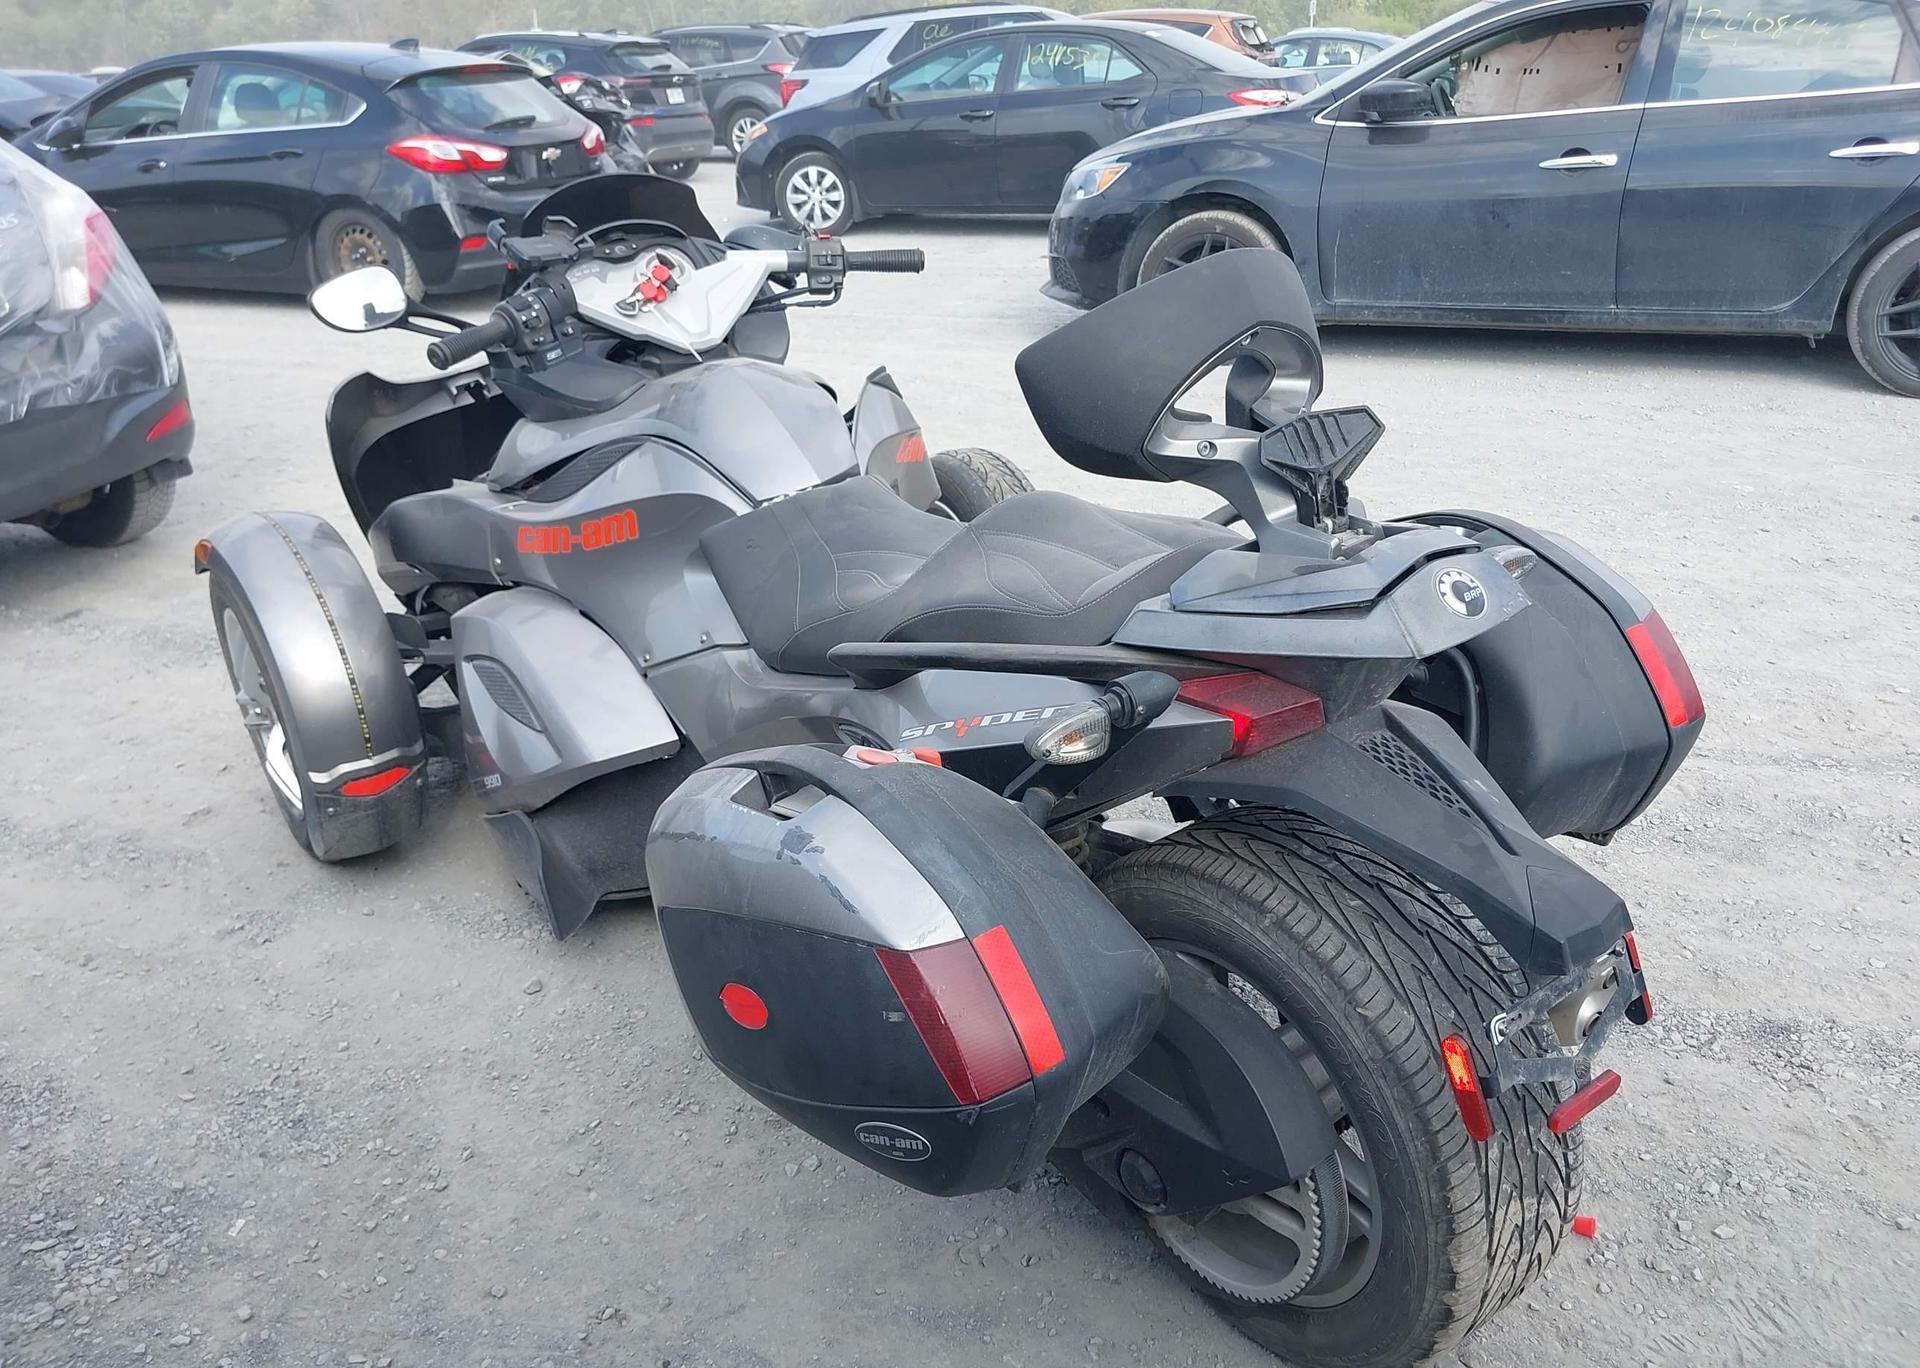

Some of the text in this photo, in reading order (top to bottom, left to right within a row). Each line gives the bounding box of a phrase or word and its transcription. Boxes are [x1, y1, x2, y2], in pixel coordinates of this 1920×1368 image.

[516, 508, 639, 554] can-am
[1463, 587, 1482, 602] BRP
[483, 773, 502, 789] 990
[859, 1131, 924, 1151] can-am
